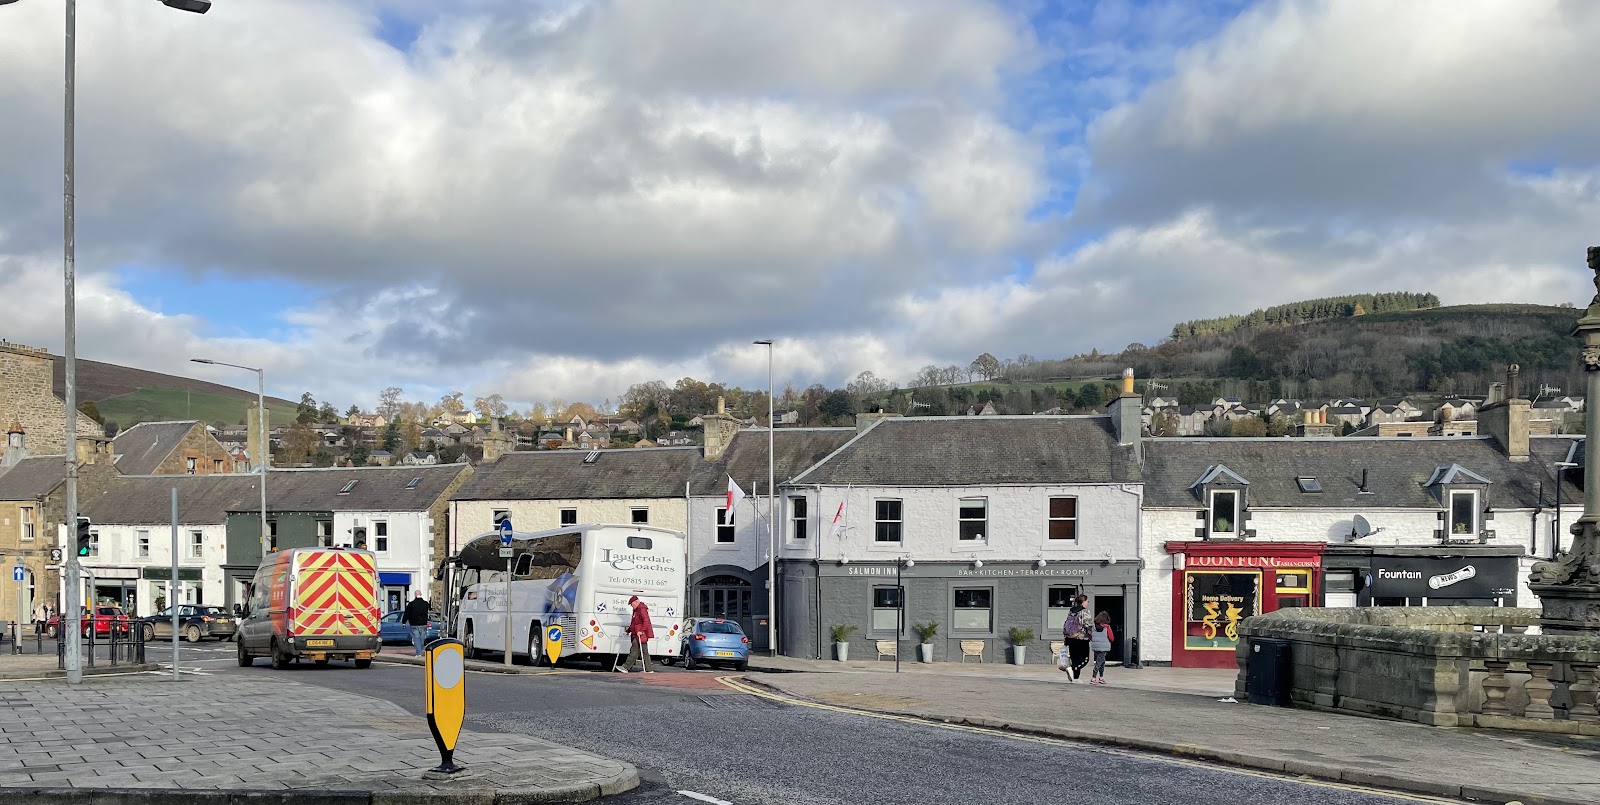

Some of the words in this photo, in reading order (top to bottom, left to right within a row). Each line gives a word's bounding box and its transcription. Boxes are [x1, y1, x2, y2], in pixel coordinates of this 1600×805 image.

[600, 548, 672, 564] Lauderdale
[1190, 556, 1234, 566] LOON
[1237, 556, 1280, 567] FUNG
[610, 559, 675, 572] Coaches
[848, 567, 881, 575] SALMON
[883, 567, 897, 575] INN
[1061, 569, 1089, 577] ROOMS
[1378, 568, 1422, 579] Fountain
[1220, 595, 1244, 603] Delivery
